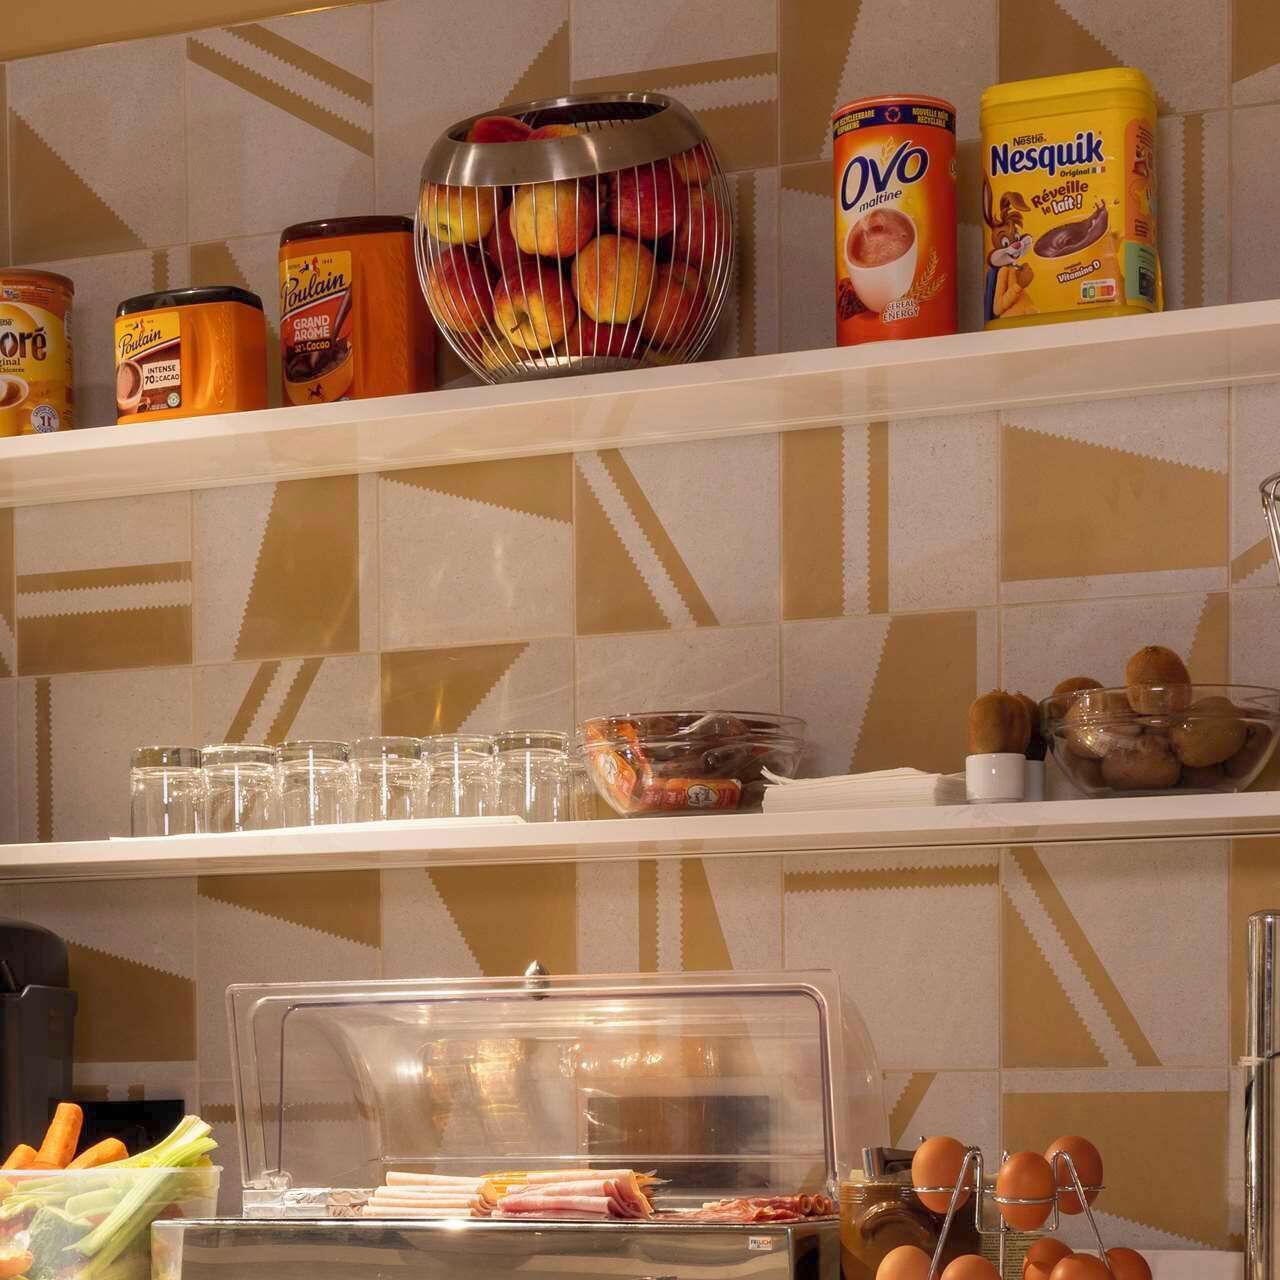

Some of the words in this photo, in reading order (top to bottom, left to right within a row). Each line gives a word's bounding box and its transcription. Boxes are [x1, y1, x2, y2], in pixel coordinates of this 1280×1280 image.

[990, 131, 1105, 177] Nesquik
[1060, 167, 1090, 178] Original
[858, 189, 903, 213] maltine
[1031, 180, 1089, 209] Réveille
[1041, 203, 1052, 215] le
[1057, 264, 1094, 283] Vitamine
[1092, 259, 1101, 270] D
[281, 271, 346, 313] Poulain
[886, 299, 914, 311] CEREAL
[883, 306, 919, 321] ENERGY
[293, 314, 330, 330] GRAND
[118, 329, 163, 359] Poulain
[147, 364, 177, 375] INTENSE
[159, 373, 180, 382] CACAO
